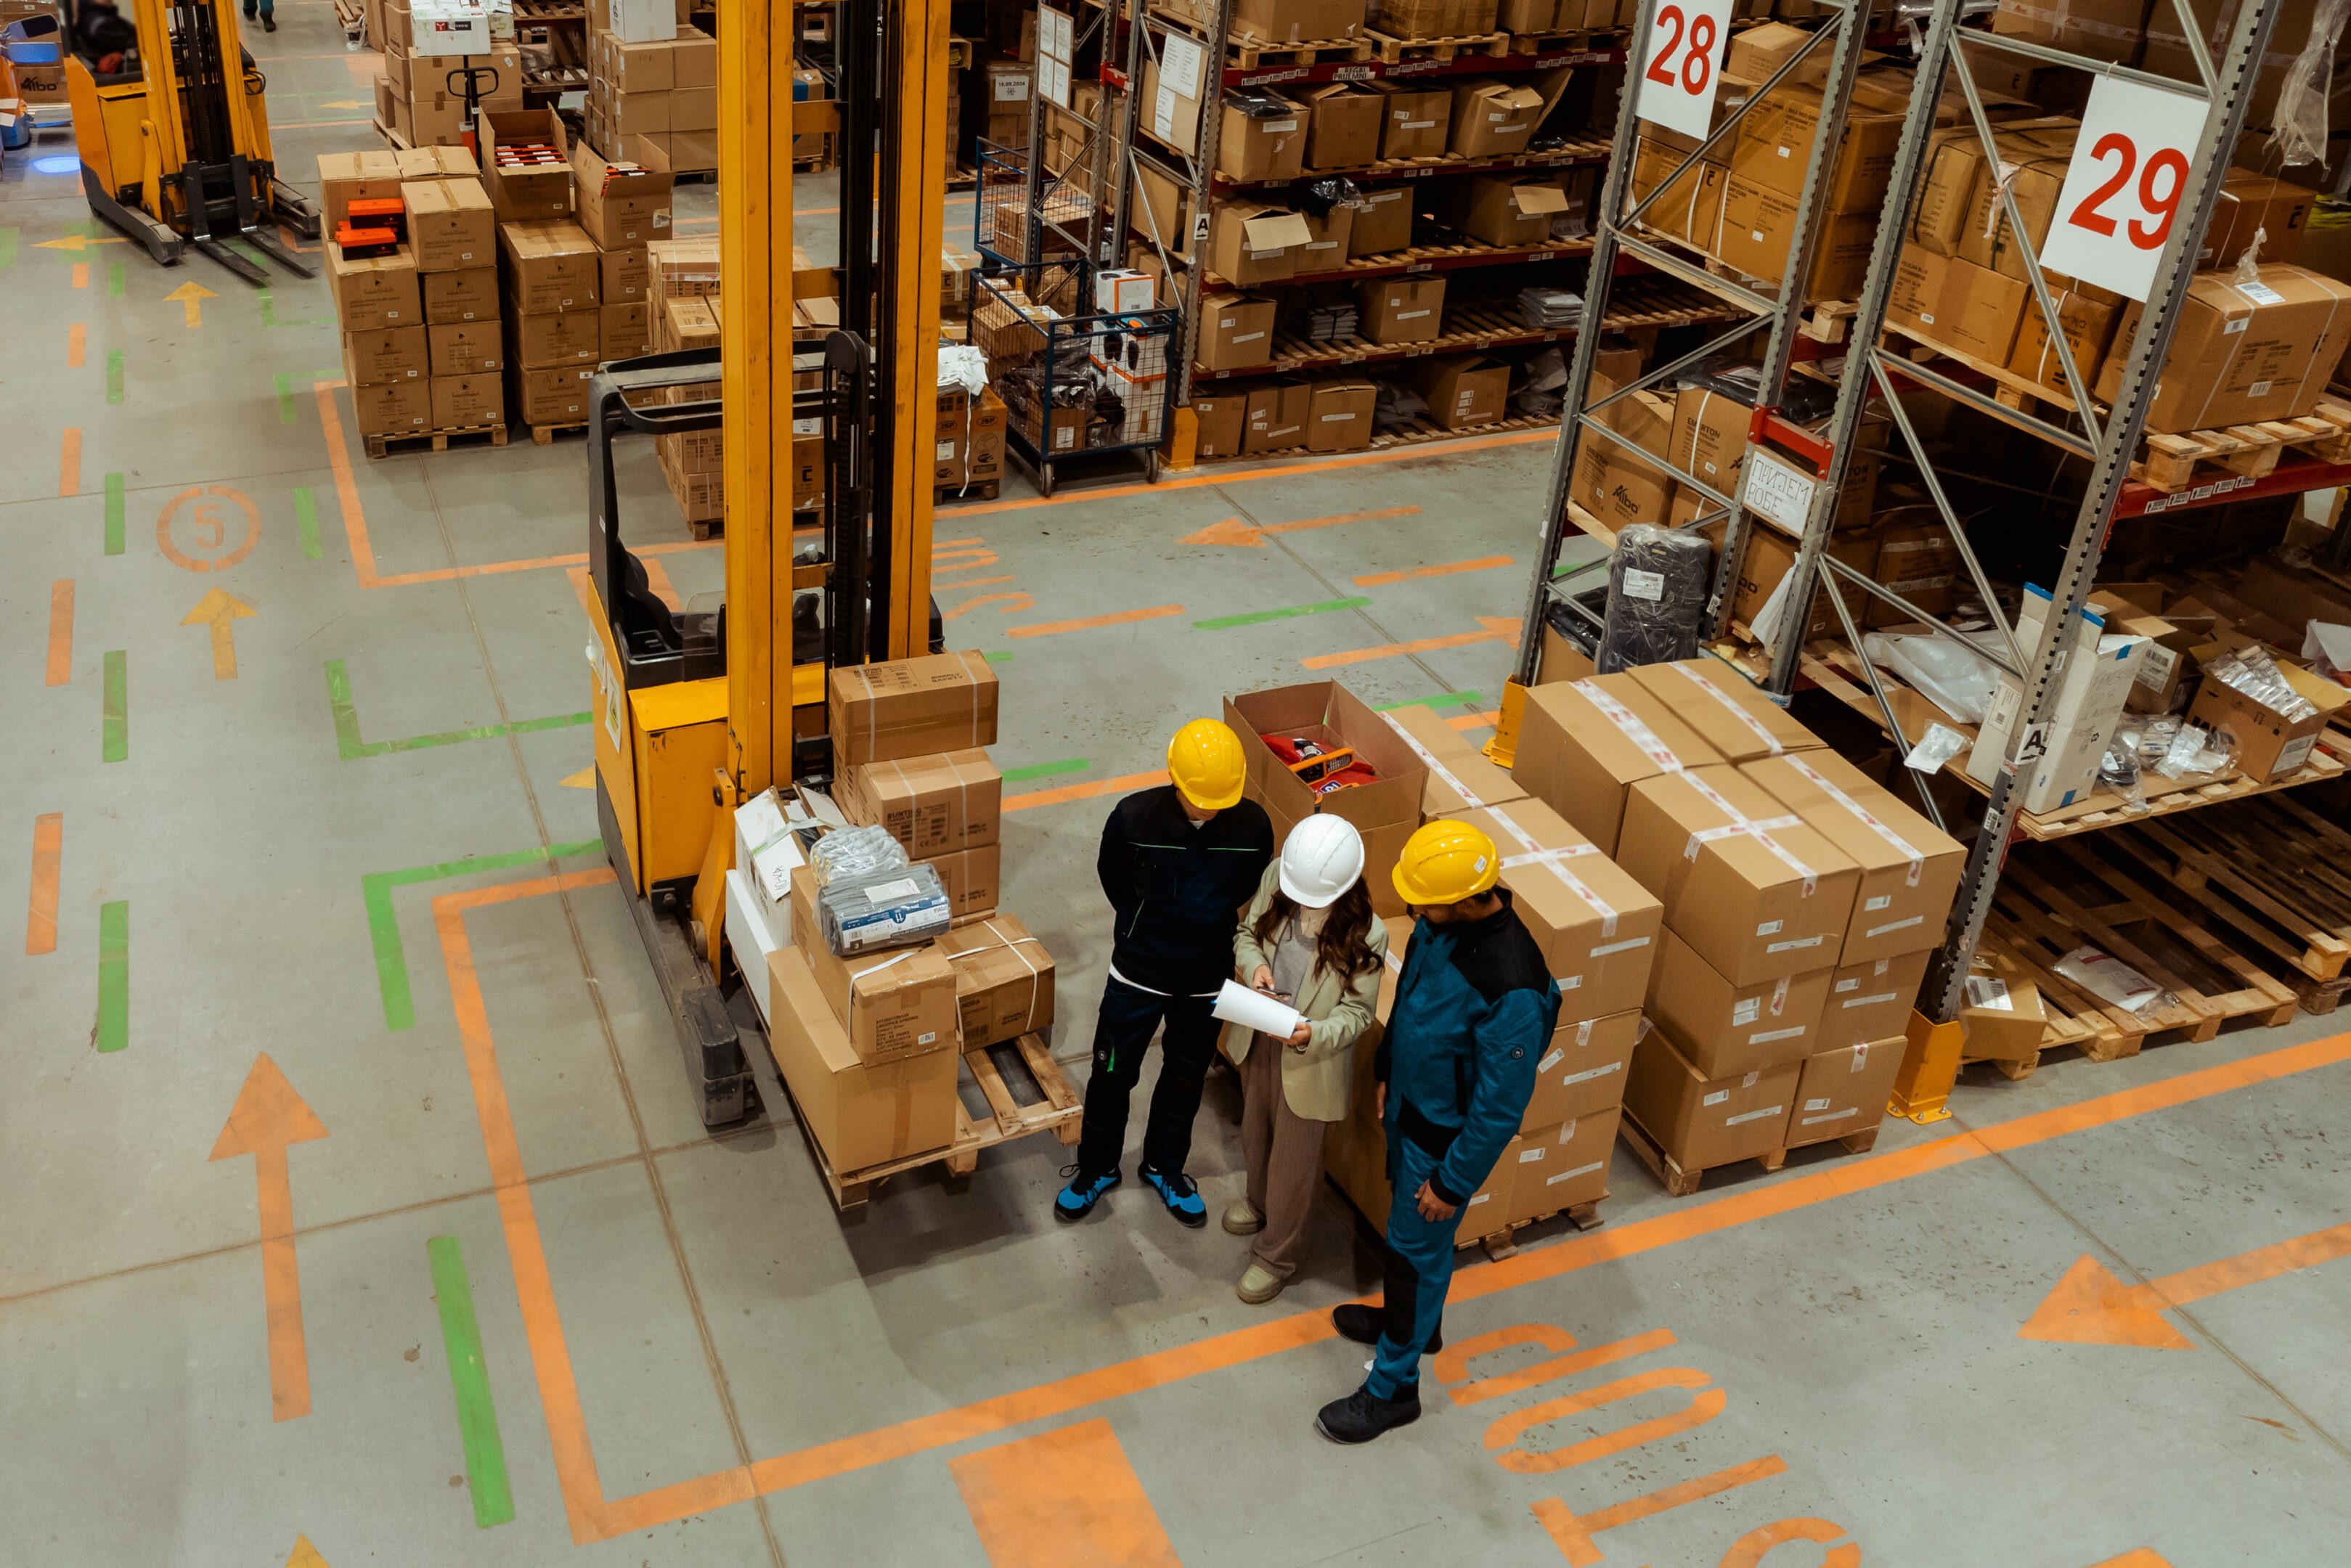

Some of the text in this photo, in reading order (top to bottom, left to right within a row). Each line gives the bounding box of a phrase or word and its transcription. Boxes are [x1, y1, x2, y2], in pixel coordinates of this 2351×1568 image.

[1646, 4, 1716, 95] 28
[2068, 133, 2190, 250] 29
[1197, 217, 1209, 232] A
[1747, 481, 1783, 518] РОБЕ
[1751, 459, 1810, 506] ПРИЈЕМ
[194, 504, 225, 550] 5
[2024, 730, 2042, 751] A
